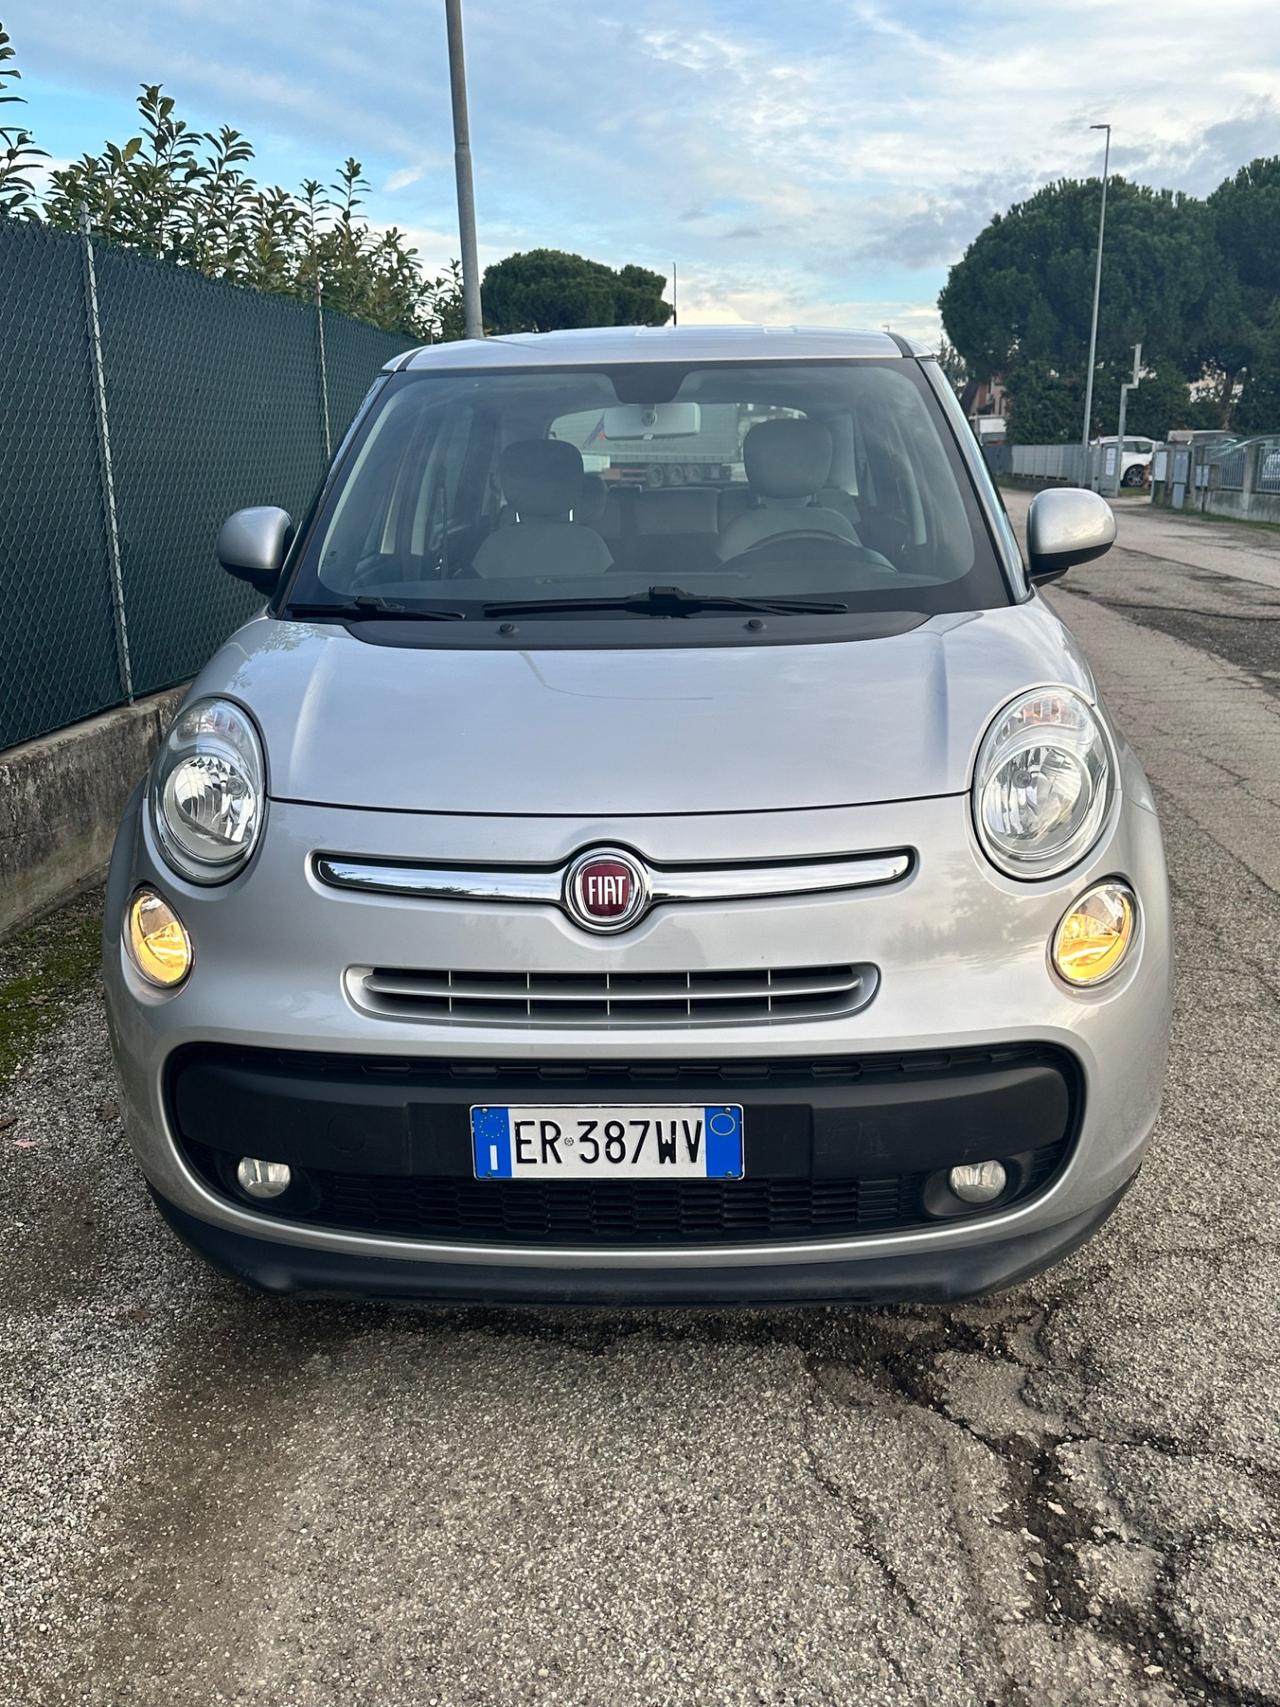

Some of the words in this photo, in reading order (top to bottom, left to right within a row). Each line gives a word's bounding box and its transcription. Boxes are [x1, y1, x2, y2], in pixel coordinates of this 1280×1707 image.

[588, 876, 626, 905] FIAT
[514, 1120, 563, 1164] ER
[576, 1120, 702, 1164] 387WV
